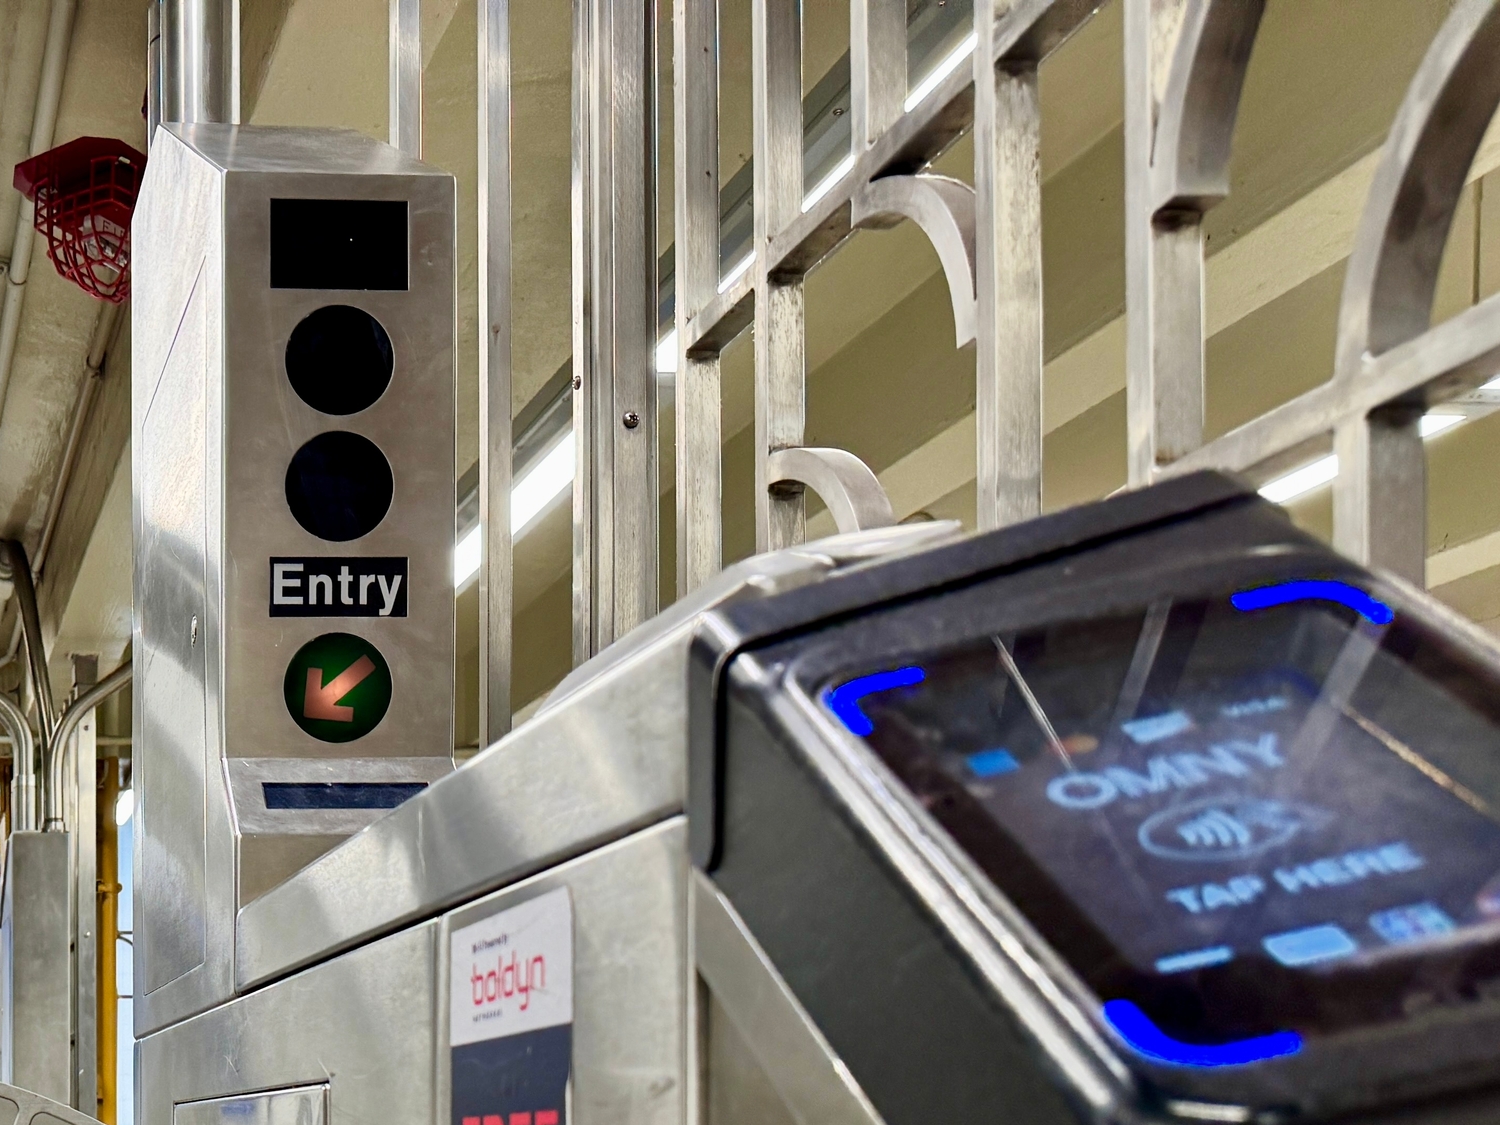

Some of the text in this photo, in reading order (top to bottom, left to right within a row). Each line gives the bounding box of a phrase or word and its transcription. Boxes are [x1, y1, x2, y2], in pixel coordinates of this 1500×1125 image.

[272, 563, 404, 617] Entry
[1046, 731, 1288, 809] OMNY
[1166, 841, 1427, 914] TAP HERE
[471, 949, 545, 1011] boldyn
